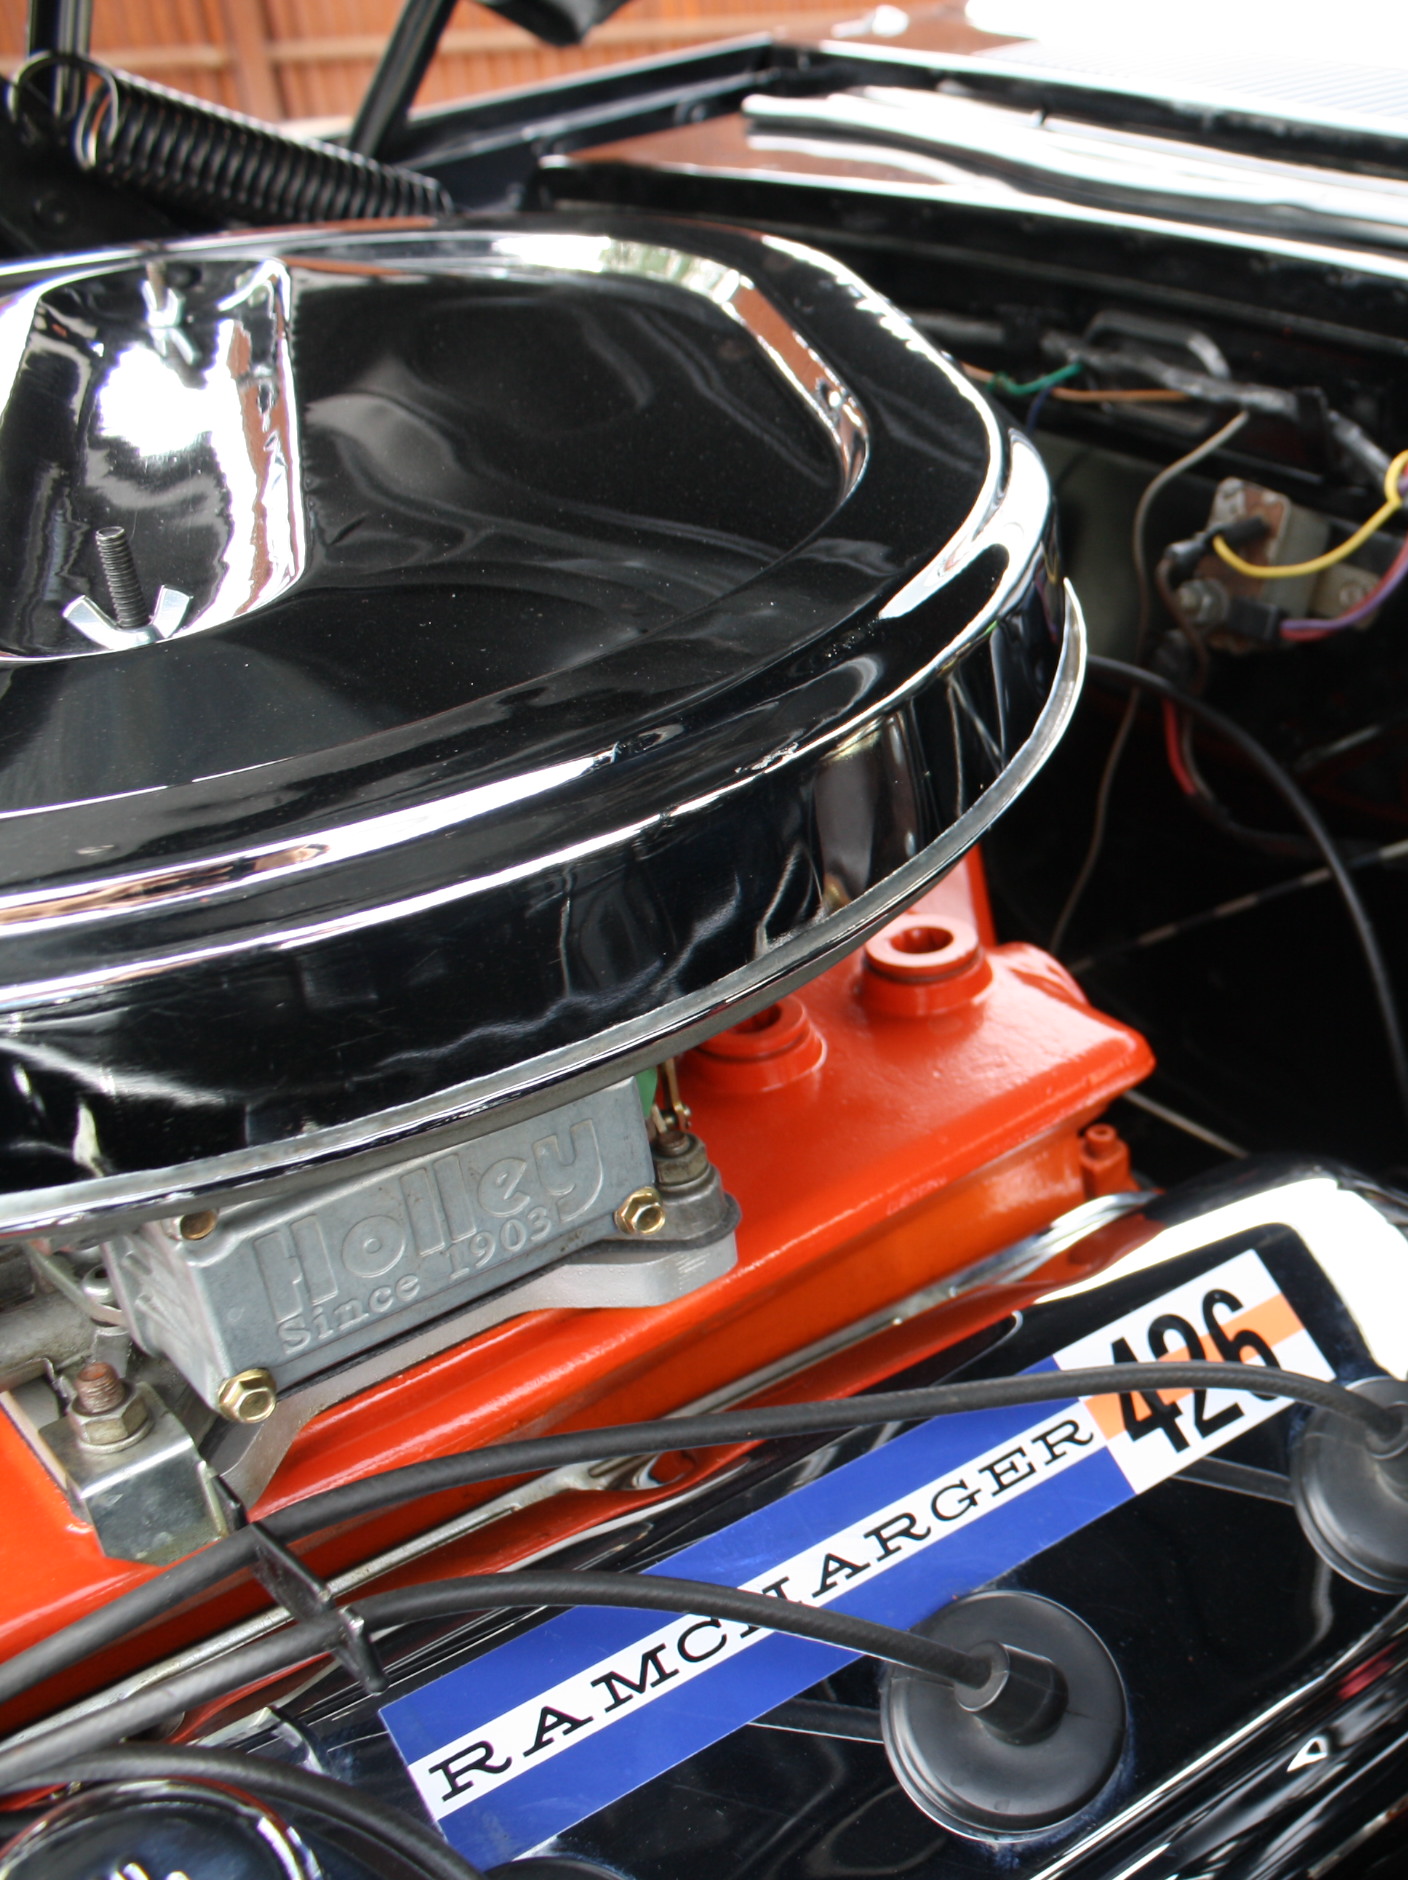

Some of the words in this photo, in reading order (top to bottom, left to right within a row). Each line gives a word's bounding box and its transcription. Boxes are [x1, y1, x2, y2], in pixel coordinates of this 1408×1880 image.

[254, 1119, 602, 1323] Holley
[278, 1277, 421, 1355] Since
[447, 1207, 554, 1281] 1903
[1110, 1288, 1282, 1454] 426
